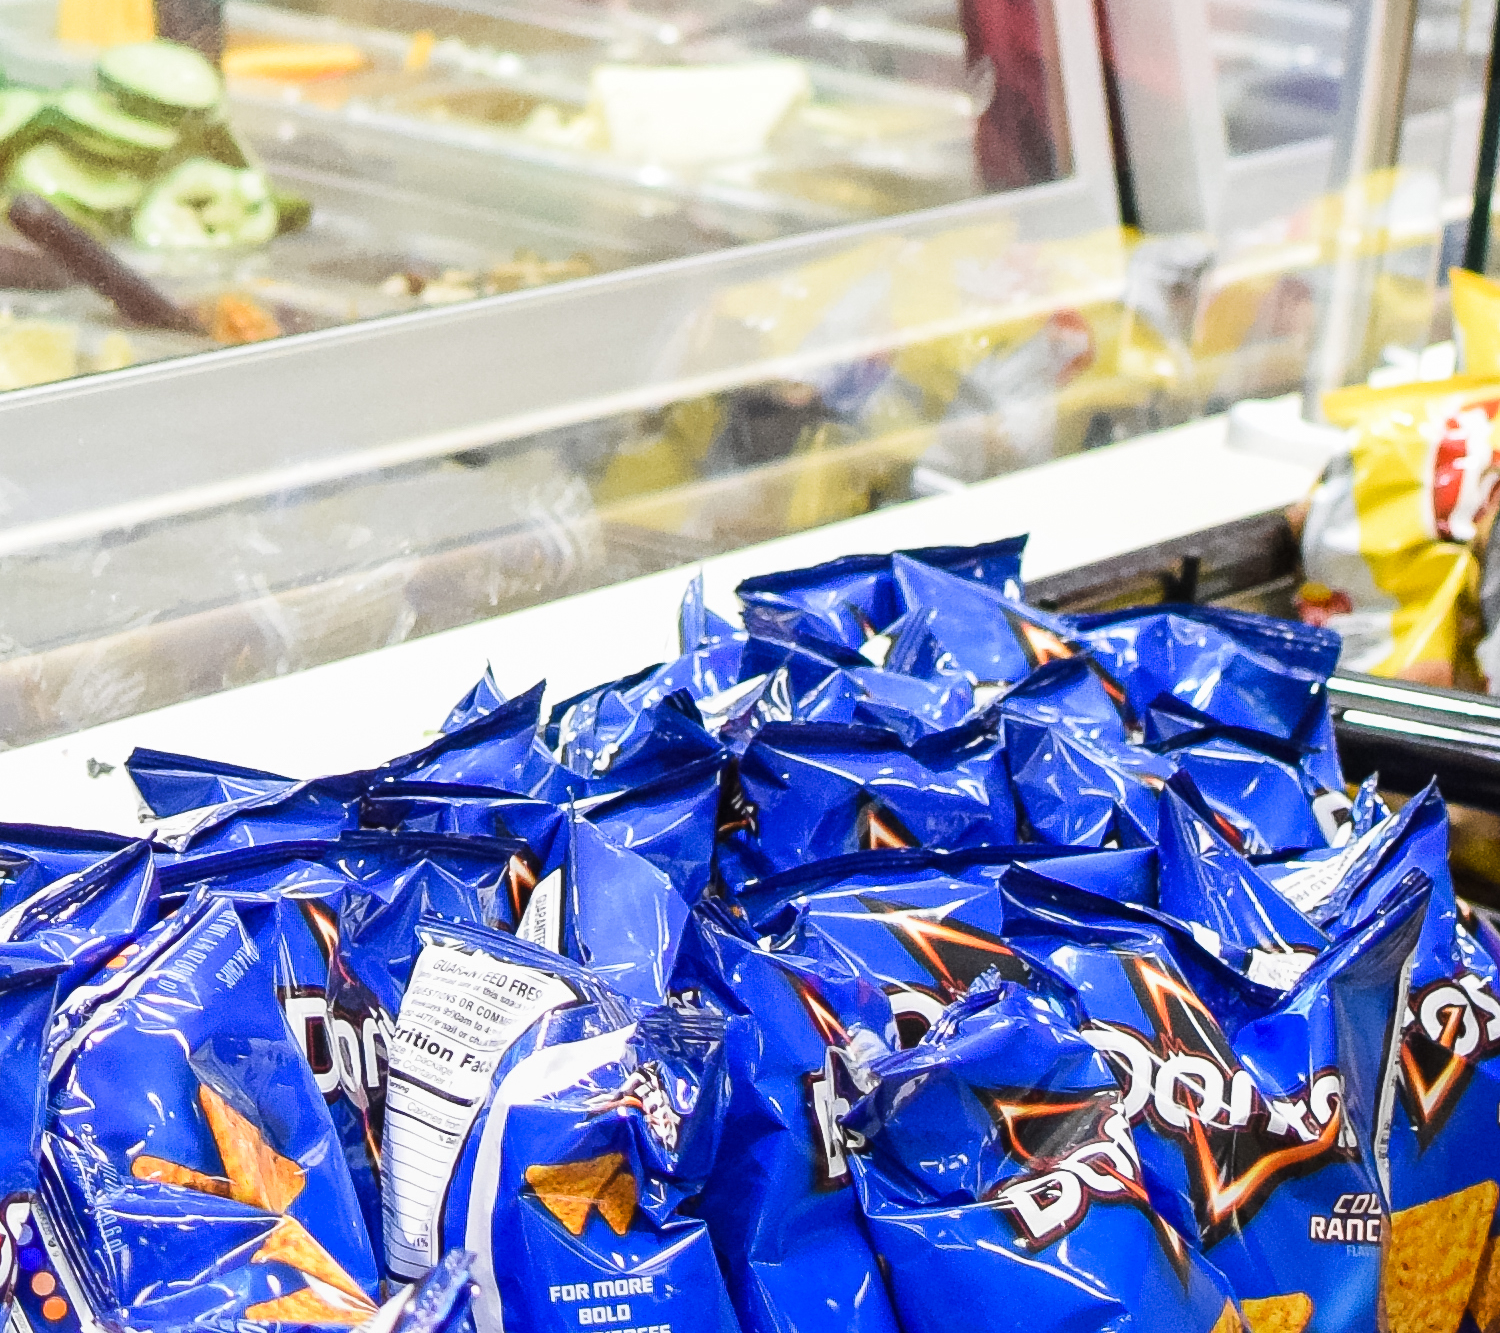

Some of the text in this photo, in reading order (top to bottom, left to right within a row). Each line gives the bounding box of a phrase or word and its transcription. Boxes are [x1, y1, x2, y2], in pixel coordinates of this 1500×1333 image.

[549, 1276, 653, 1303] FOR MORE
[578, 1303, 631, 1325] BOLD
